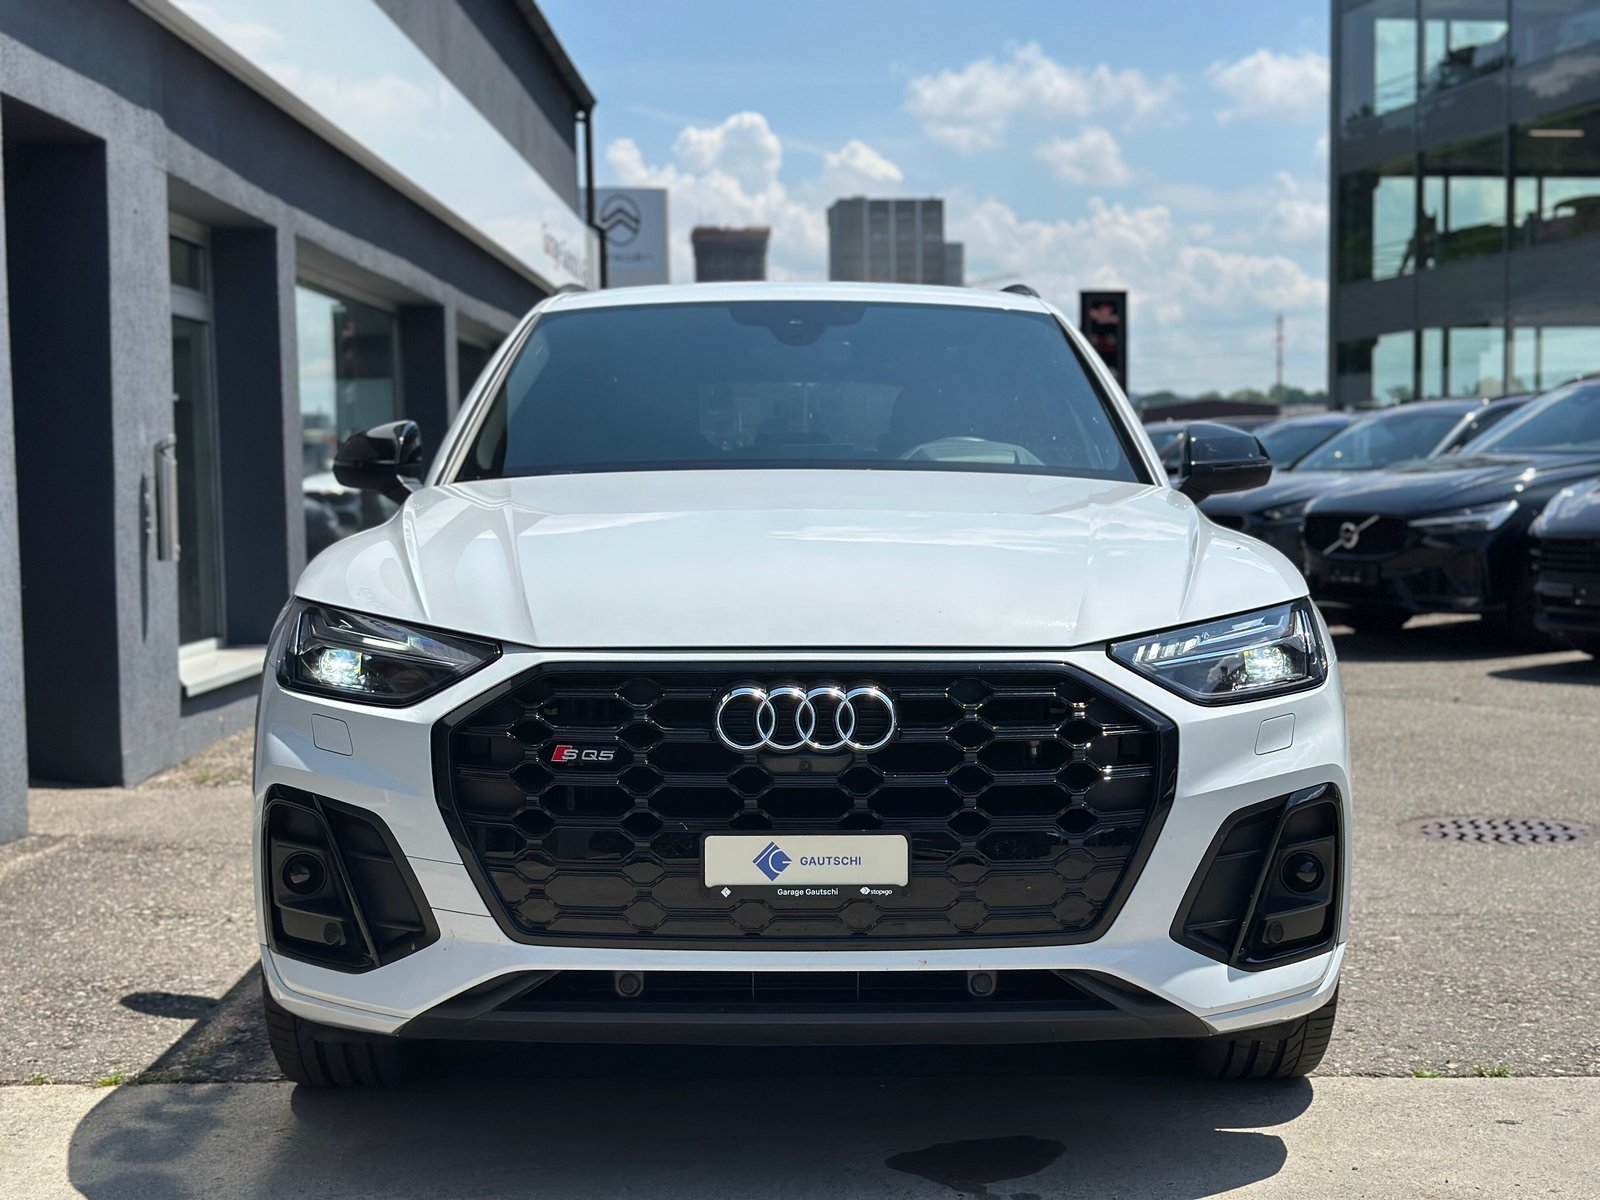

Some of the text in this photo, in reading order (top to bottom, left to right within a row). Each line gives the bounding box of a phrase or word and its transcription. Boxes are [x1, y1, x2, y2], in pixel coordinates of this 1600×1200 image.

[559, 747, 616, 762] SQ5
[799, 856, 862, 866] GAUTSCHI
[777, 887, 839, 897] Garage Gautschi
